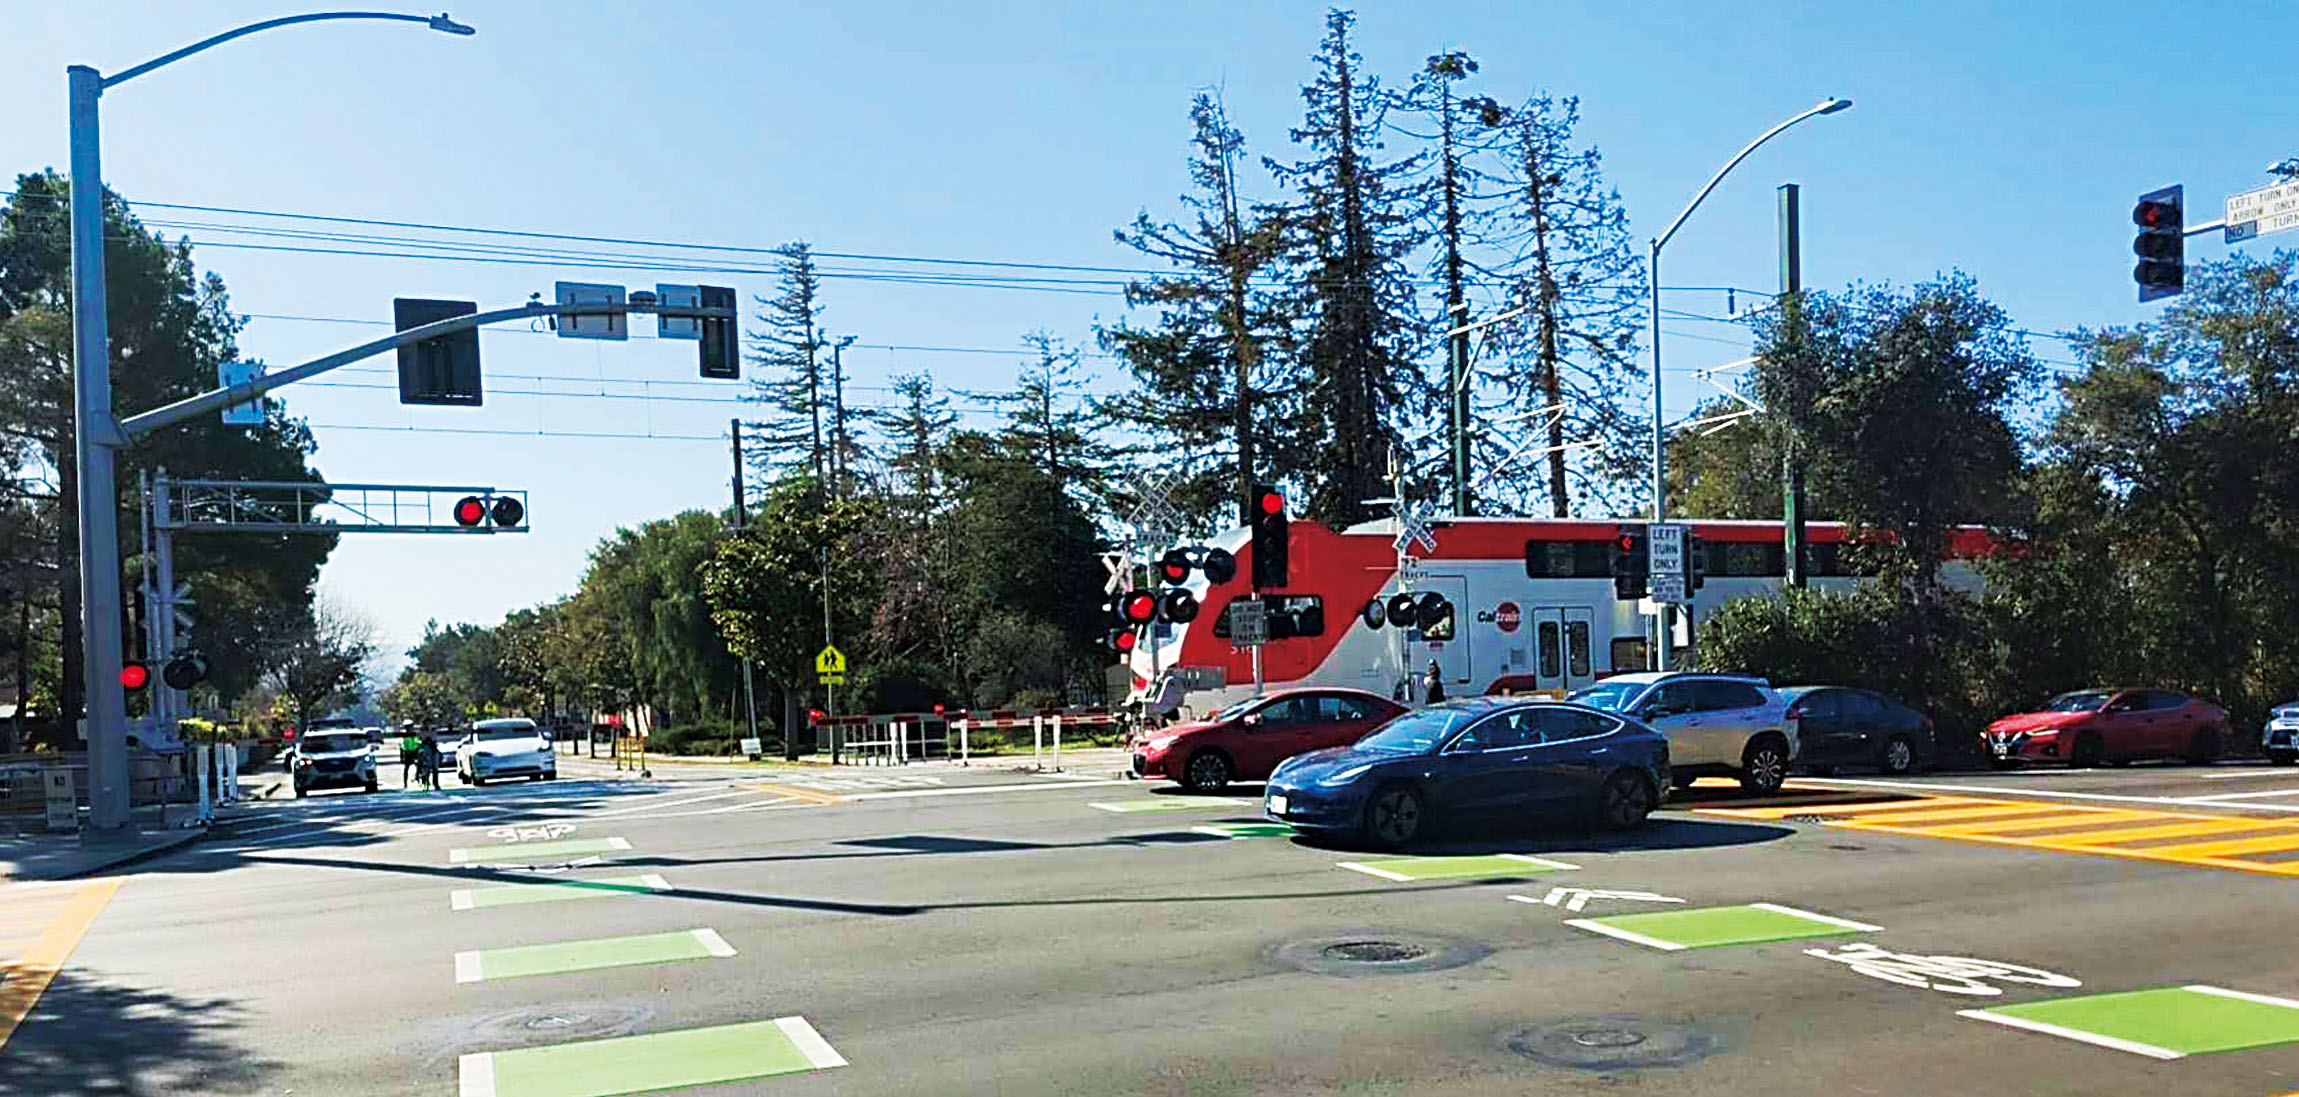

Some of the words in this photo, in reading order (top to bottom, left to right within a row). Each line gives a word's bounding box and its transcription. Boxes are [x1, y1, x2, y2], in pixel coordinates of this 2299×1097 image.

[2230, 197, 2251, 210] LEFT
[2259, 189, 2282, 203] TURN
[2233, 205, 2264, 221] ARROW
[2274, 199, 2296, 213] ONLY
[2229, 225, 2244, 238] NO
[1152, 519, 1160, 530] 2
[1653, 528, 1677, 540] LEFT
[1654, 543, 1678, 555] TURN
[1654, 558, 1678, 570] ONLY
[1478, 610, 1519, 622] Caltrain
